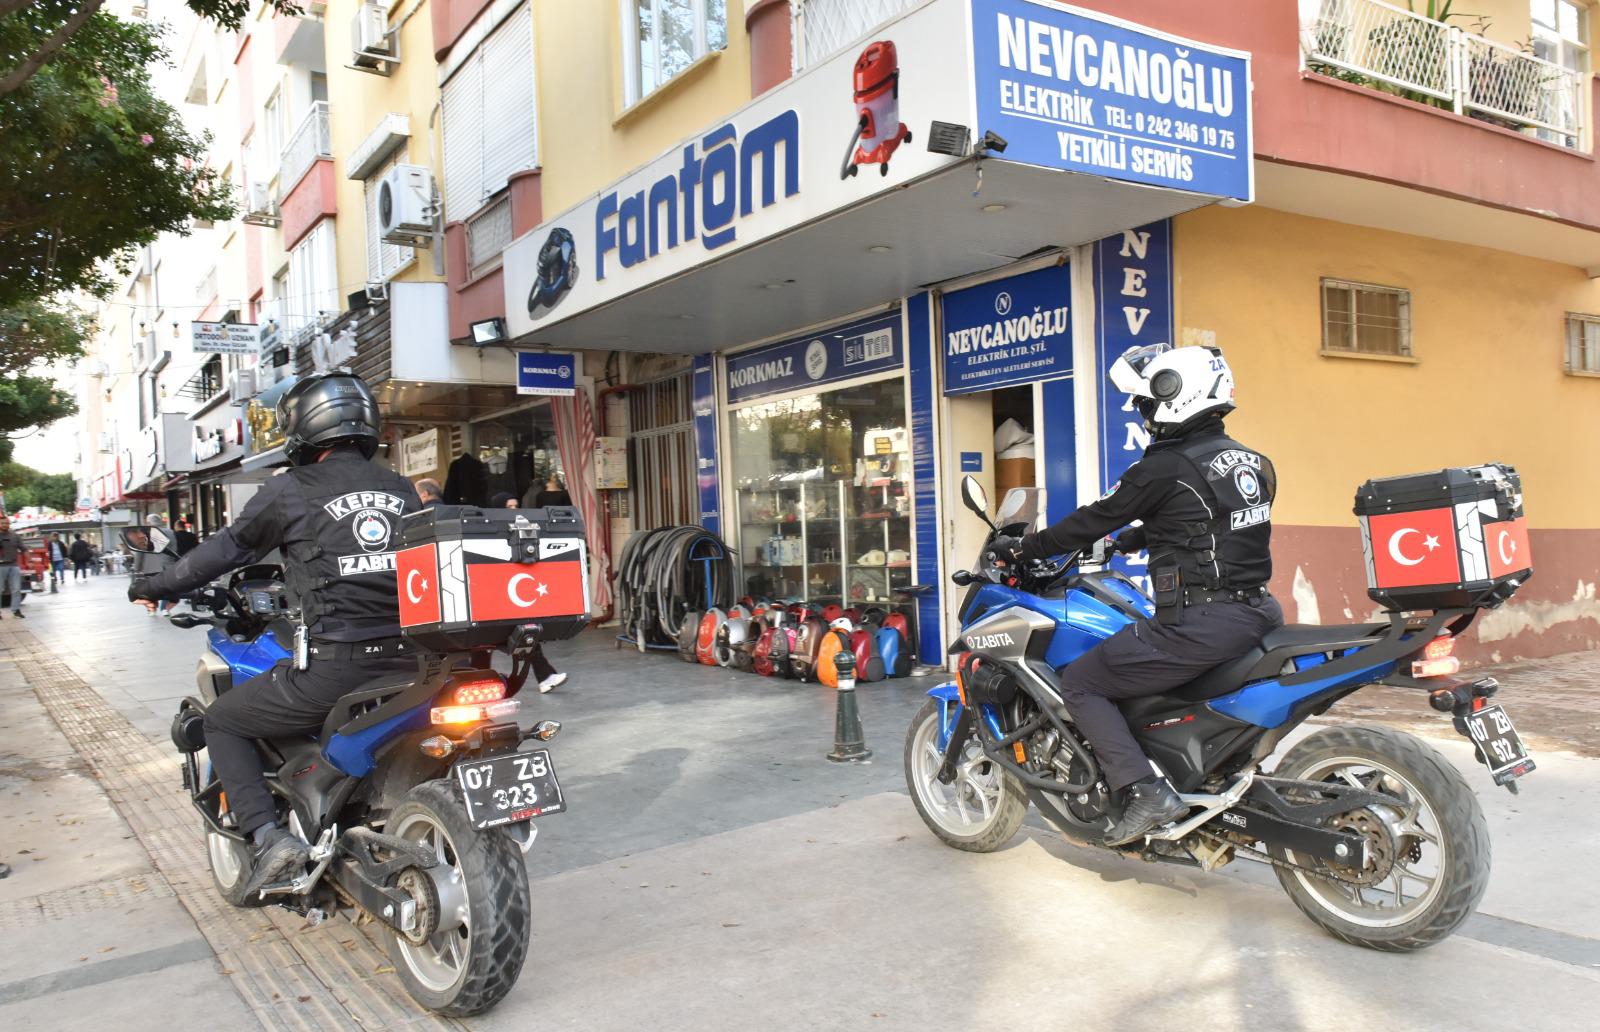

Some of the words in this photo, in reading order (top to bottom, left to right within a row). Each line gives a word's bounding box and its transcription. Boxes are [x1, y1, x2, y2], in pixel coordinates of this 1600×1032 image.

[997, 12, 1233, 117] NEVCANOĞLU
[1000, 79, 1094, 126] ELEKTRİK
[1105, 105, 1132, 129] TEL:
[1135, 112, 1144, 132] 0
[1147, 115, 1172, 138] 242
[1175, 120, 1198, 142] 346
[1202, 126, 1217, 147] 19
[1218, 129, 1235, 150] 75
[1057, 131, 1126, 170] YETKİLİ
[1131, 145, 1194, 182] SERVİS
[948, 305, 1068, 356] NEVCANOĞLU
[968, 349, 1009, 366] ELEKTRİK
[1010, 346, 1029, 357] LTD.
[1030, 340, 1047, 356] ŞTİ.
[730, 356, 794, 389] KORKMAZ
[1213, 451, 1259, 473] KEPEZ
[330, 493, 400, 517] KEPEZ
[341, 553, 397, 574] ZABIT
[974, 633, 1015, 649] ZABITA
[1470, 717, 1490, 742] 07
[1489, 711, 1512, 735] ZB
[1491, 738, 1517, 763] 512
[465, 764, 493, 790] 07
[513, 756, 548, 781] ZB
[493, 782, 538, 810] 323
